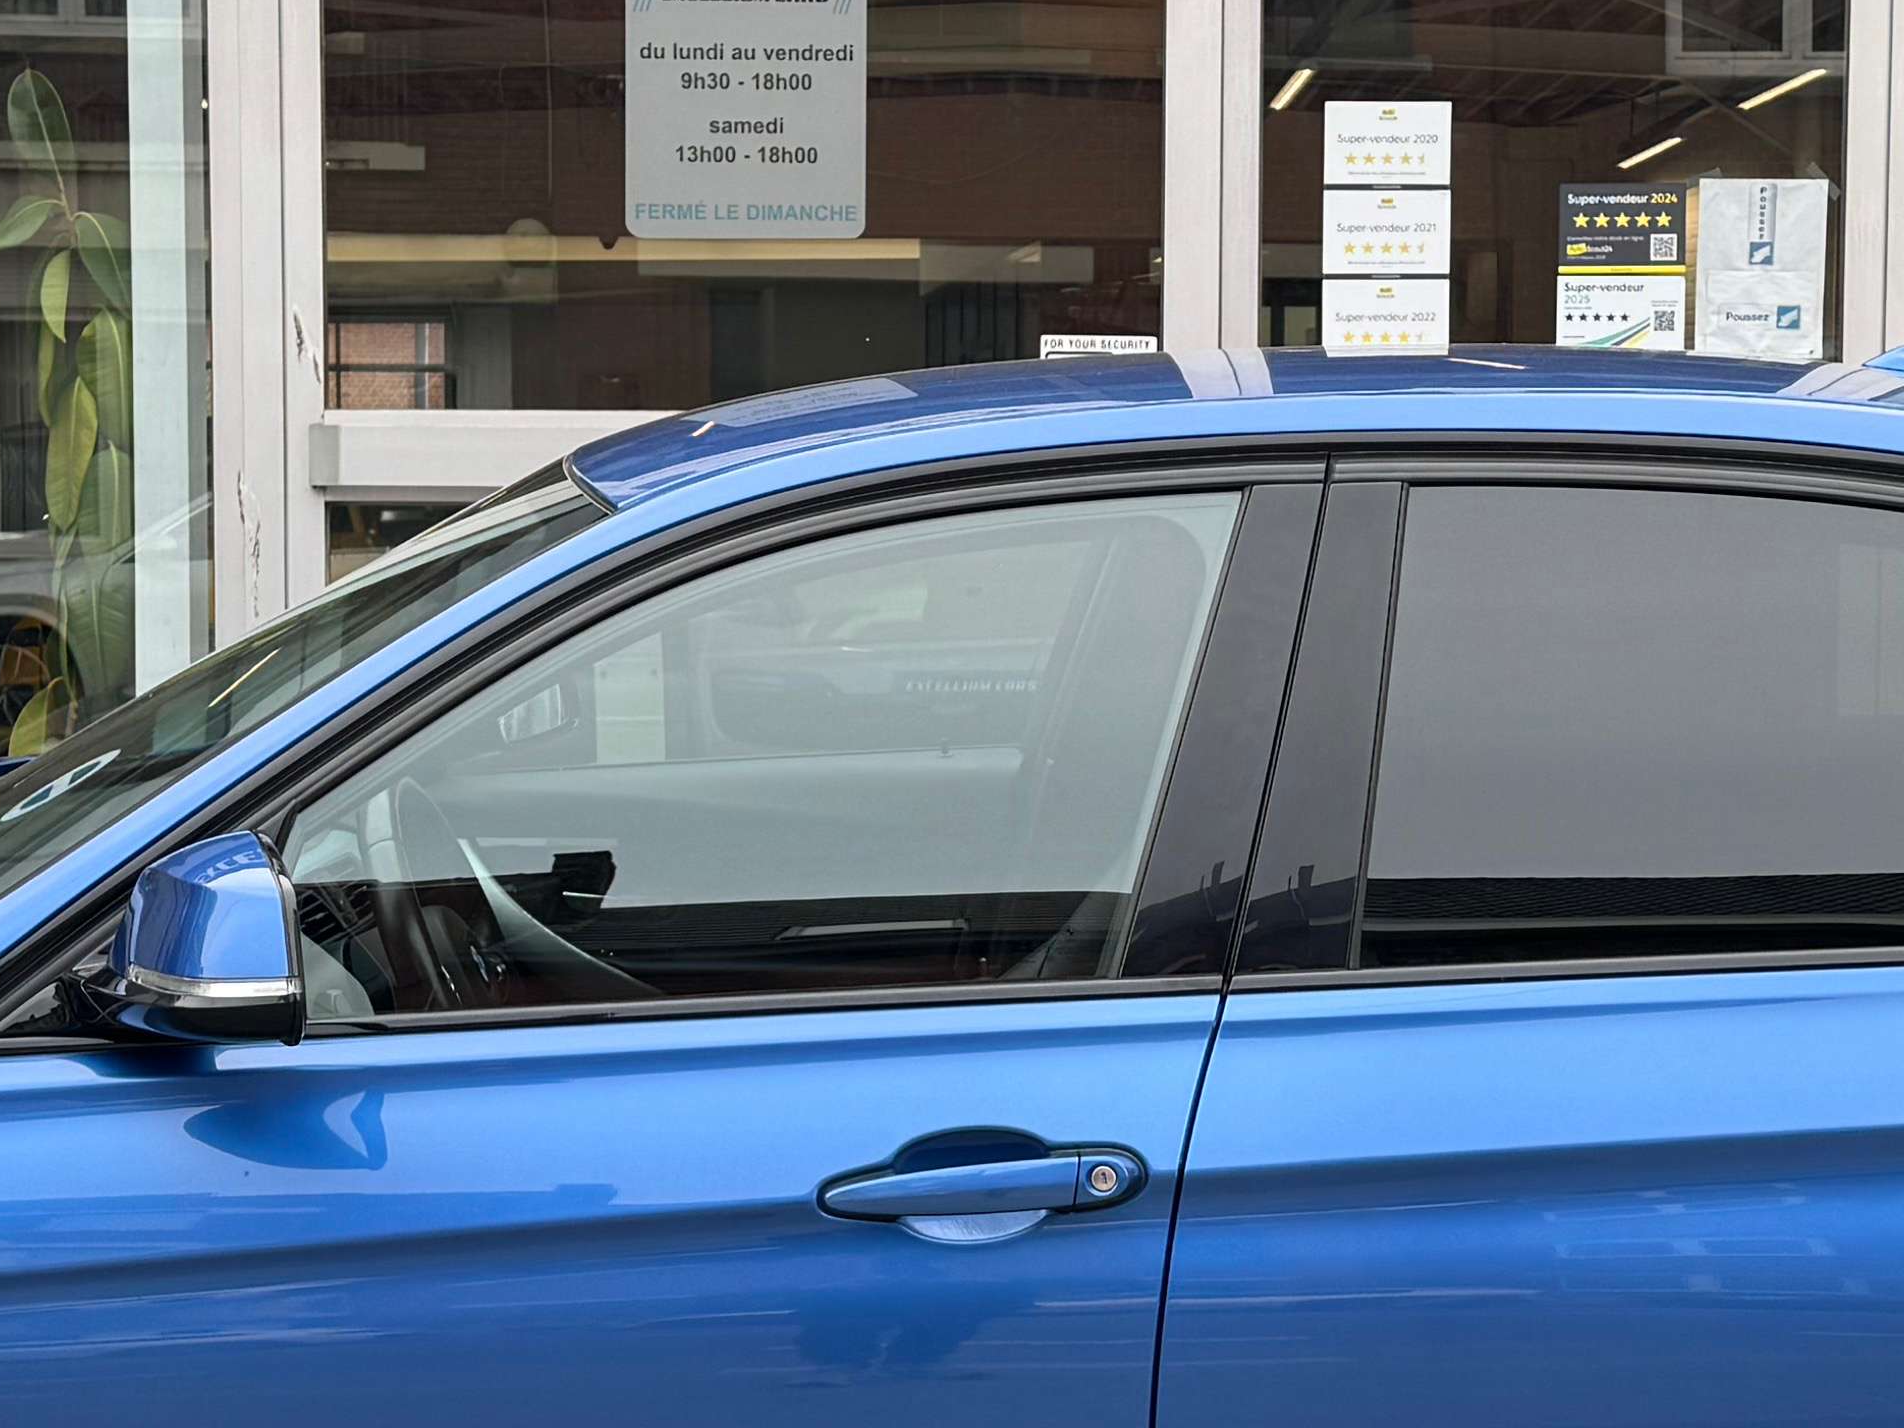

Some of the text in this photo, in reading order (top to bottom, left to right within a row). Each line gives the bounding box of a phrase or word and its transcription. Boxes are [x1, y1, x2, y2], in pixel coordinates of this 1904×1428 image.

[639, 42, 855, 62] du lundi au vendredi
[680, 73, 731, 91] 9h30
[751, 73, 813, 91] 18h00
[709, 117, 785, 135] samedi
[1413, 133, 1439, 144] 2020
[675, 145, 737, 164] 13h00
[757, 147, 819, 165] 18h00
[1567, 192, 1678, 206] Super-vendeur 2024
[634, 201, 858, 222] FERMÉ LE DIMANCHE
[1413, 223, 1437, 233] 2021
[1563, 282, 1645, 293] Super-vendeur
[1411, 312, 1437, 322] 2022
[1044, 338, 1151, 349] FOR YOUR SECURITY
